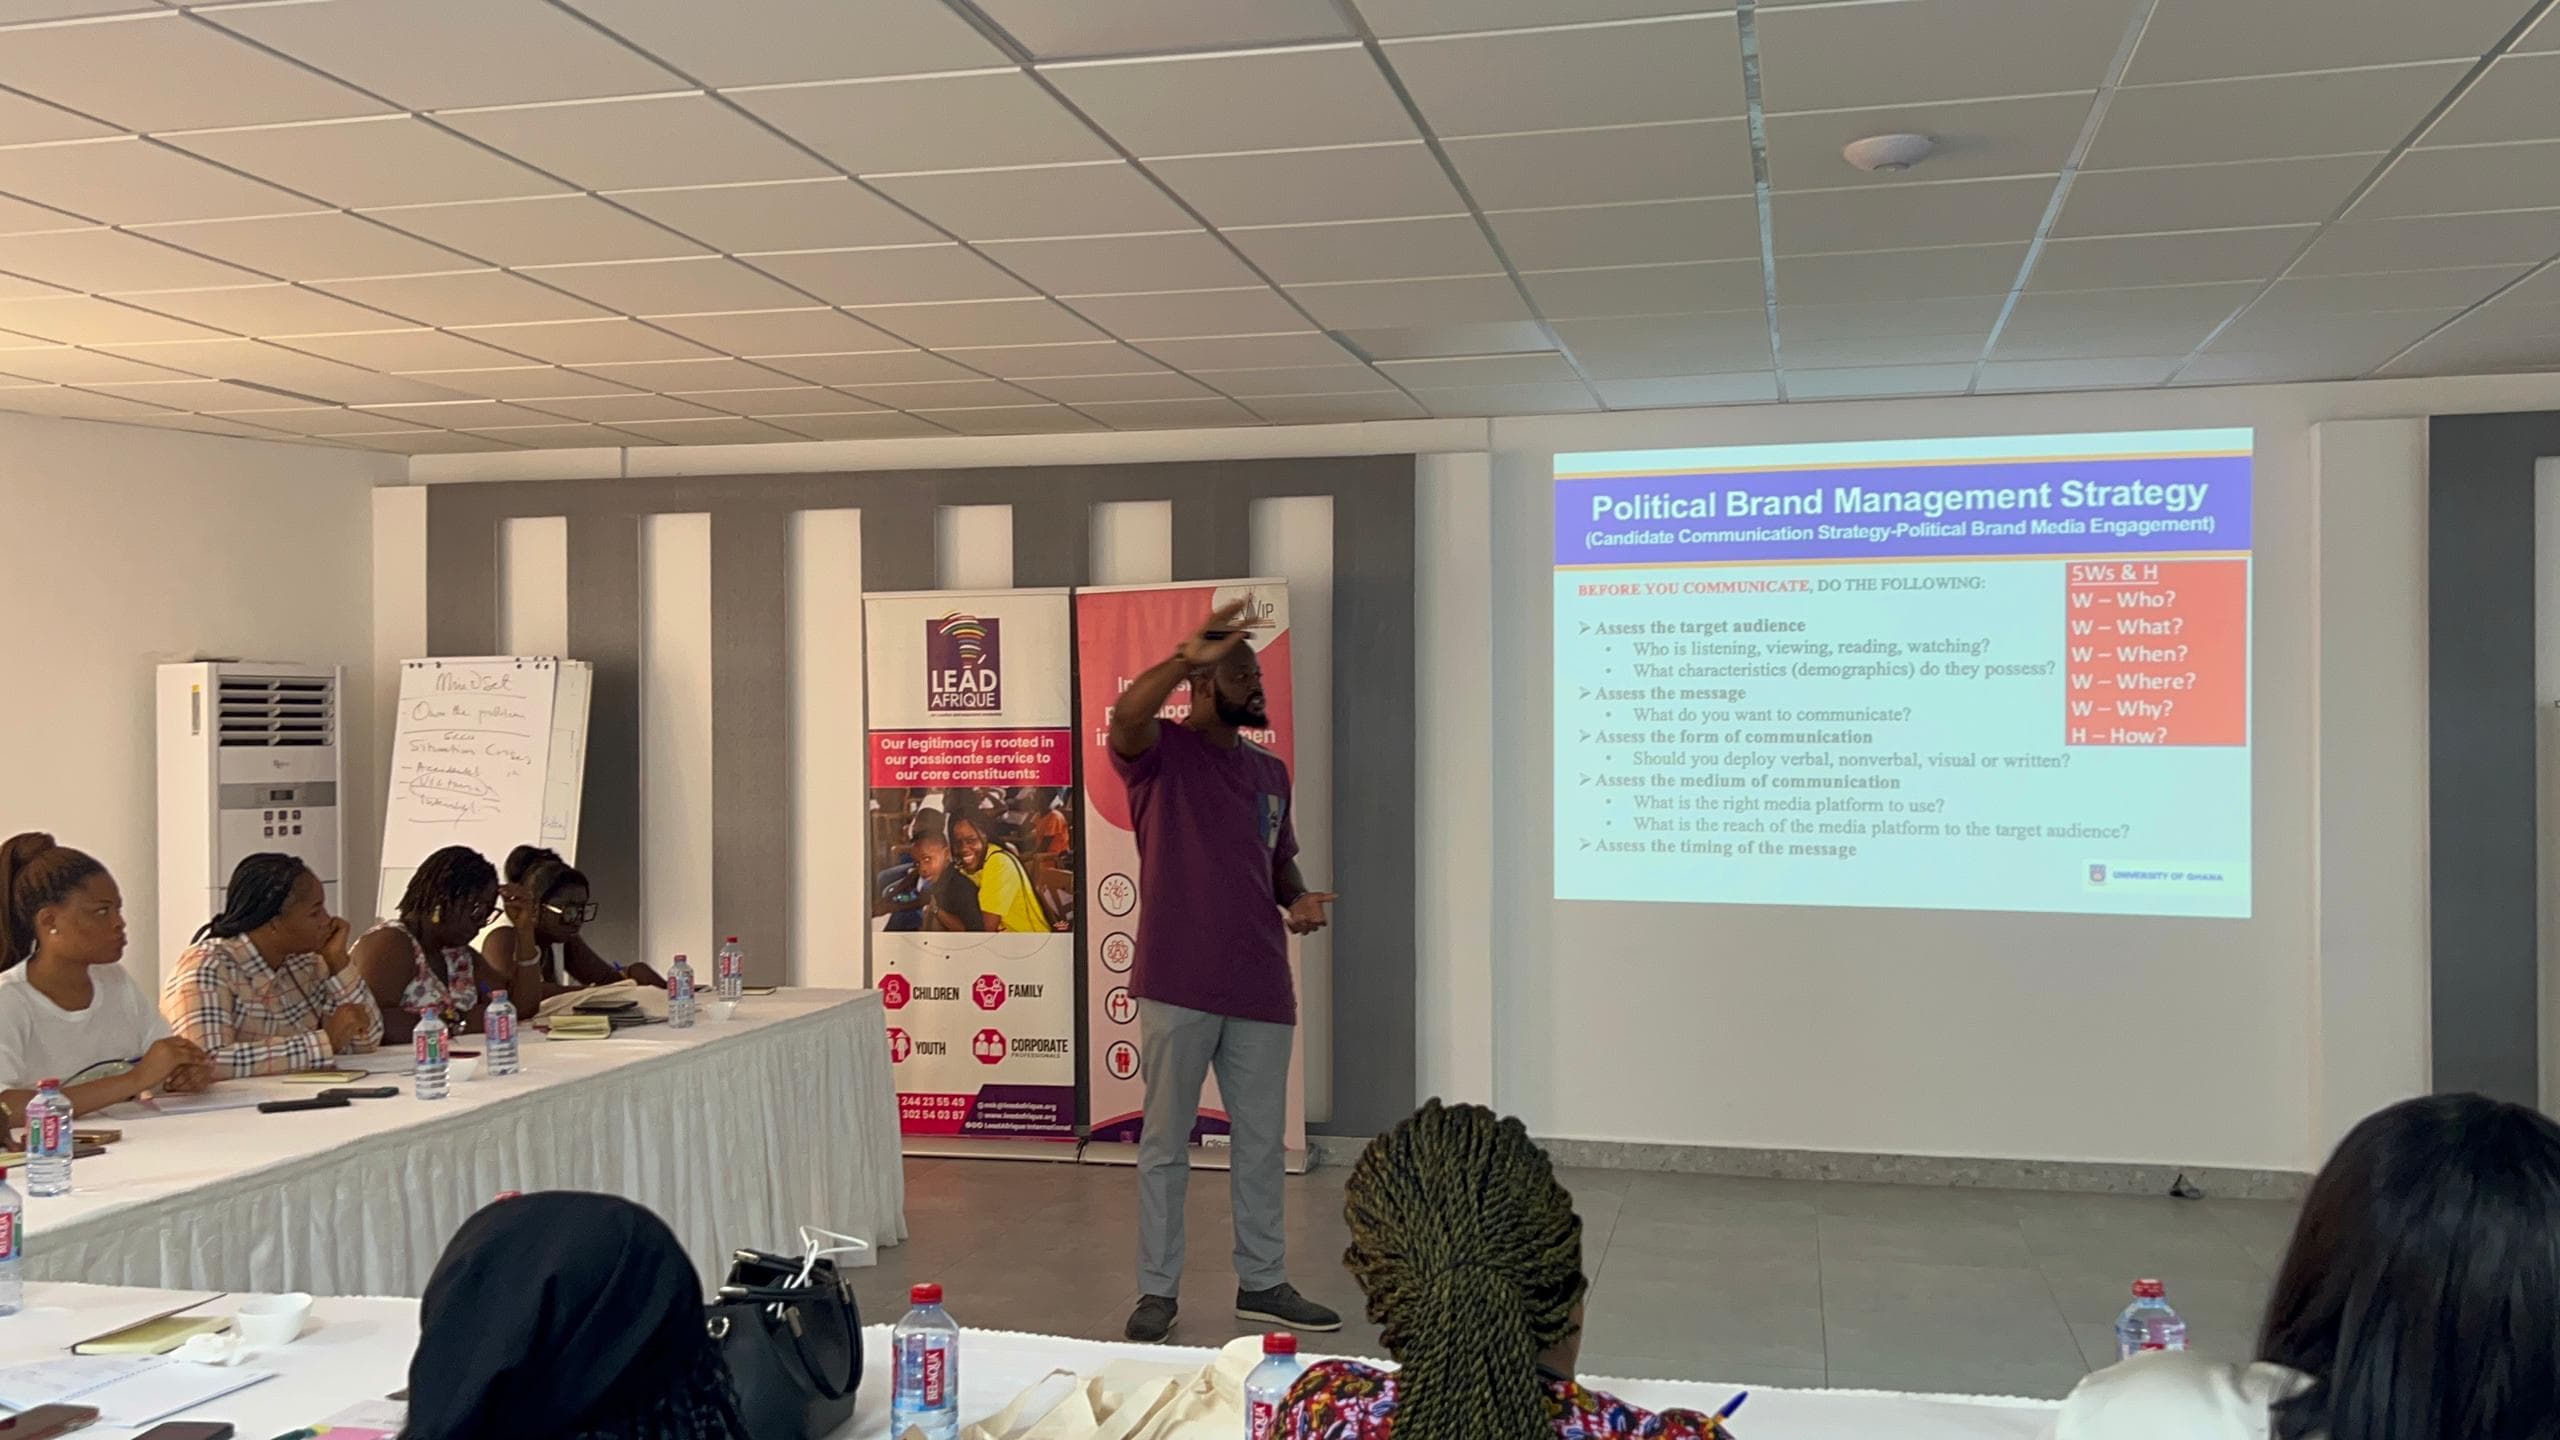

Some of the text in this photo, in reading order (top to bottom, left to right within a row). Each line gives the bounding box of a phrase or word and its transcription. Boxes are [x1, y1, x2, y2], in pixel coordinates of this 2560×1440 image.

[1592, 479, 2209, 521] Political Brand Management Strategy
[1585, 516, 2215, 549] (Candidate Communication Strategy-Political Brand Media Engagement)
[2072, 564, 2158, 582] 5Ws & H
[1578, 576, 1986, 597] BEFORE YOU COMMUNICATE, DO THE FOLLOWING:
[2072, 592, 2093, 608] W
[2117, 590, 2176, 608] Who?
[1595, 618, 1806, 636] Assess the target audience
[2072, 619, 2093, 636] W
[2117, 617, 2183, 635] What?
[1633, 638, 1990, 658] Who is listening, viewing, reading, watching?
[2072, 646, 2093, 663] W
[2117, 645, 2188, 662] When?
[1633, 660, 2056, 680] What characteristics (demographics) do they possess?
[2072, 673, 2093, 690] W
[2117, 671, 2196, 690] Where?
[931, 692, 995, 708] AFRIQUE
[1595, 686, 1746, 703] Assess the message
[1633, 706, 1911, 725] What do you want to communicate?
[2072, 700, 2093, 717] W
[2117, 699, 2173, 720] Why?
[881, 735, 1054, 753] Our legitimacy is rooted in
[1595, 729, 1873, 744] Assess the form of communication
[2072, 728, 2086, 744] H
[2111, 727, 2168, 744] How?
[885, 752, 1051, 768] our passionate service to
[1633, 751, 2071, 769] Should you deploy verbal, nonverbal, visual or written?
[896, 768, 1040, 780] our core constituents:
[1595, 774, 1901, 790] Assess the medium of communication
[1633, 795, 1945, 814] What is the right media platform to use?
[1633, 817, 2130, 841] What is the reach of the media platform to the target audience?
[1595, 838, 1857, 860] Assess the timing of the message
[2112, 871, 2224, 881] UNIVERSITY OF GHANA
[912, 986, 960, 1001] CHILDREN
[1008, 984, 1044, 998] FAMILY
[915, 1042, 946, 1055] YOUTH
[1011, 1038, 1069, 1053] CORPORATE
[901, 1096, 921, 1107] 244
[922, 1097, 935, 1107] 23
[936, 1097, 950, 1107] 55
[902, 1110, 921, 1119] 302
[922, 1110, 935, 1119] 54
[952, 1110, 965, 1120] 87
